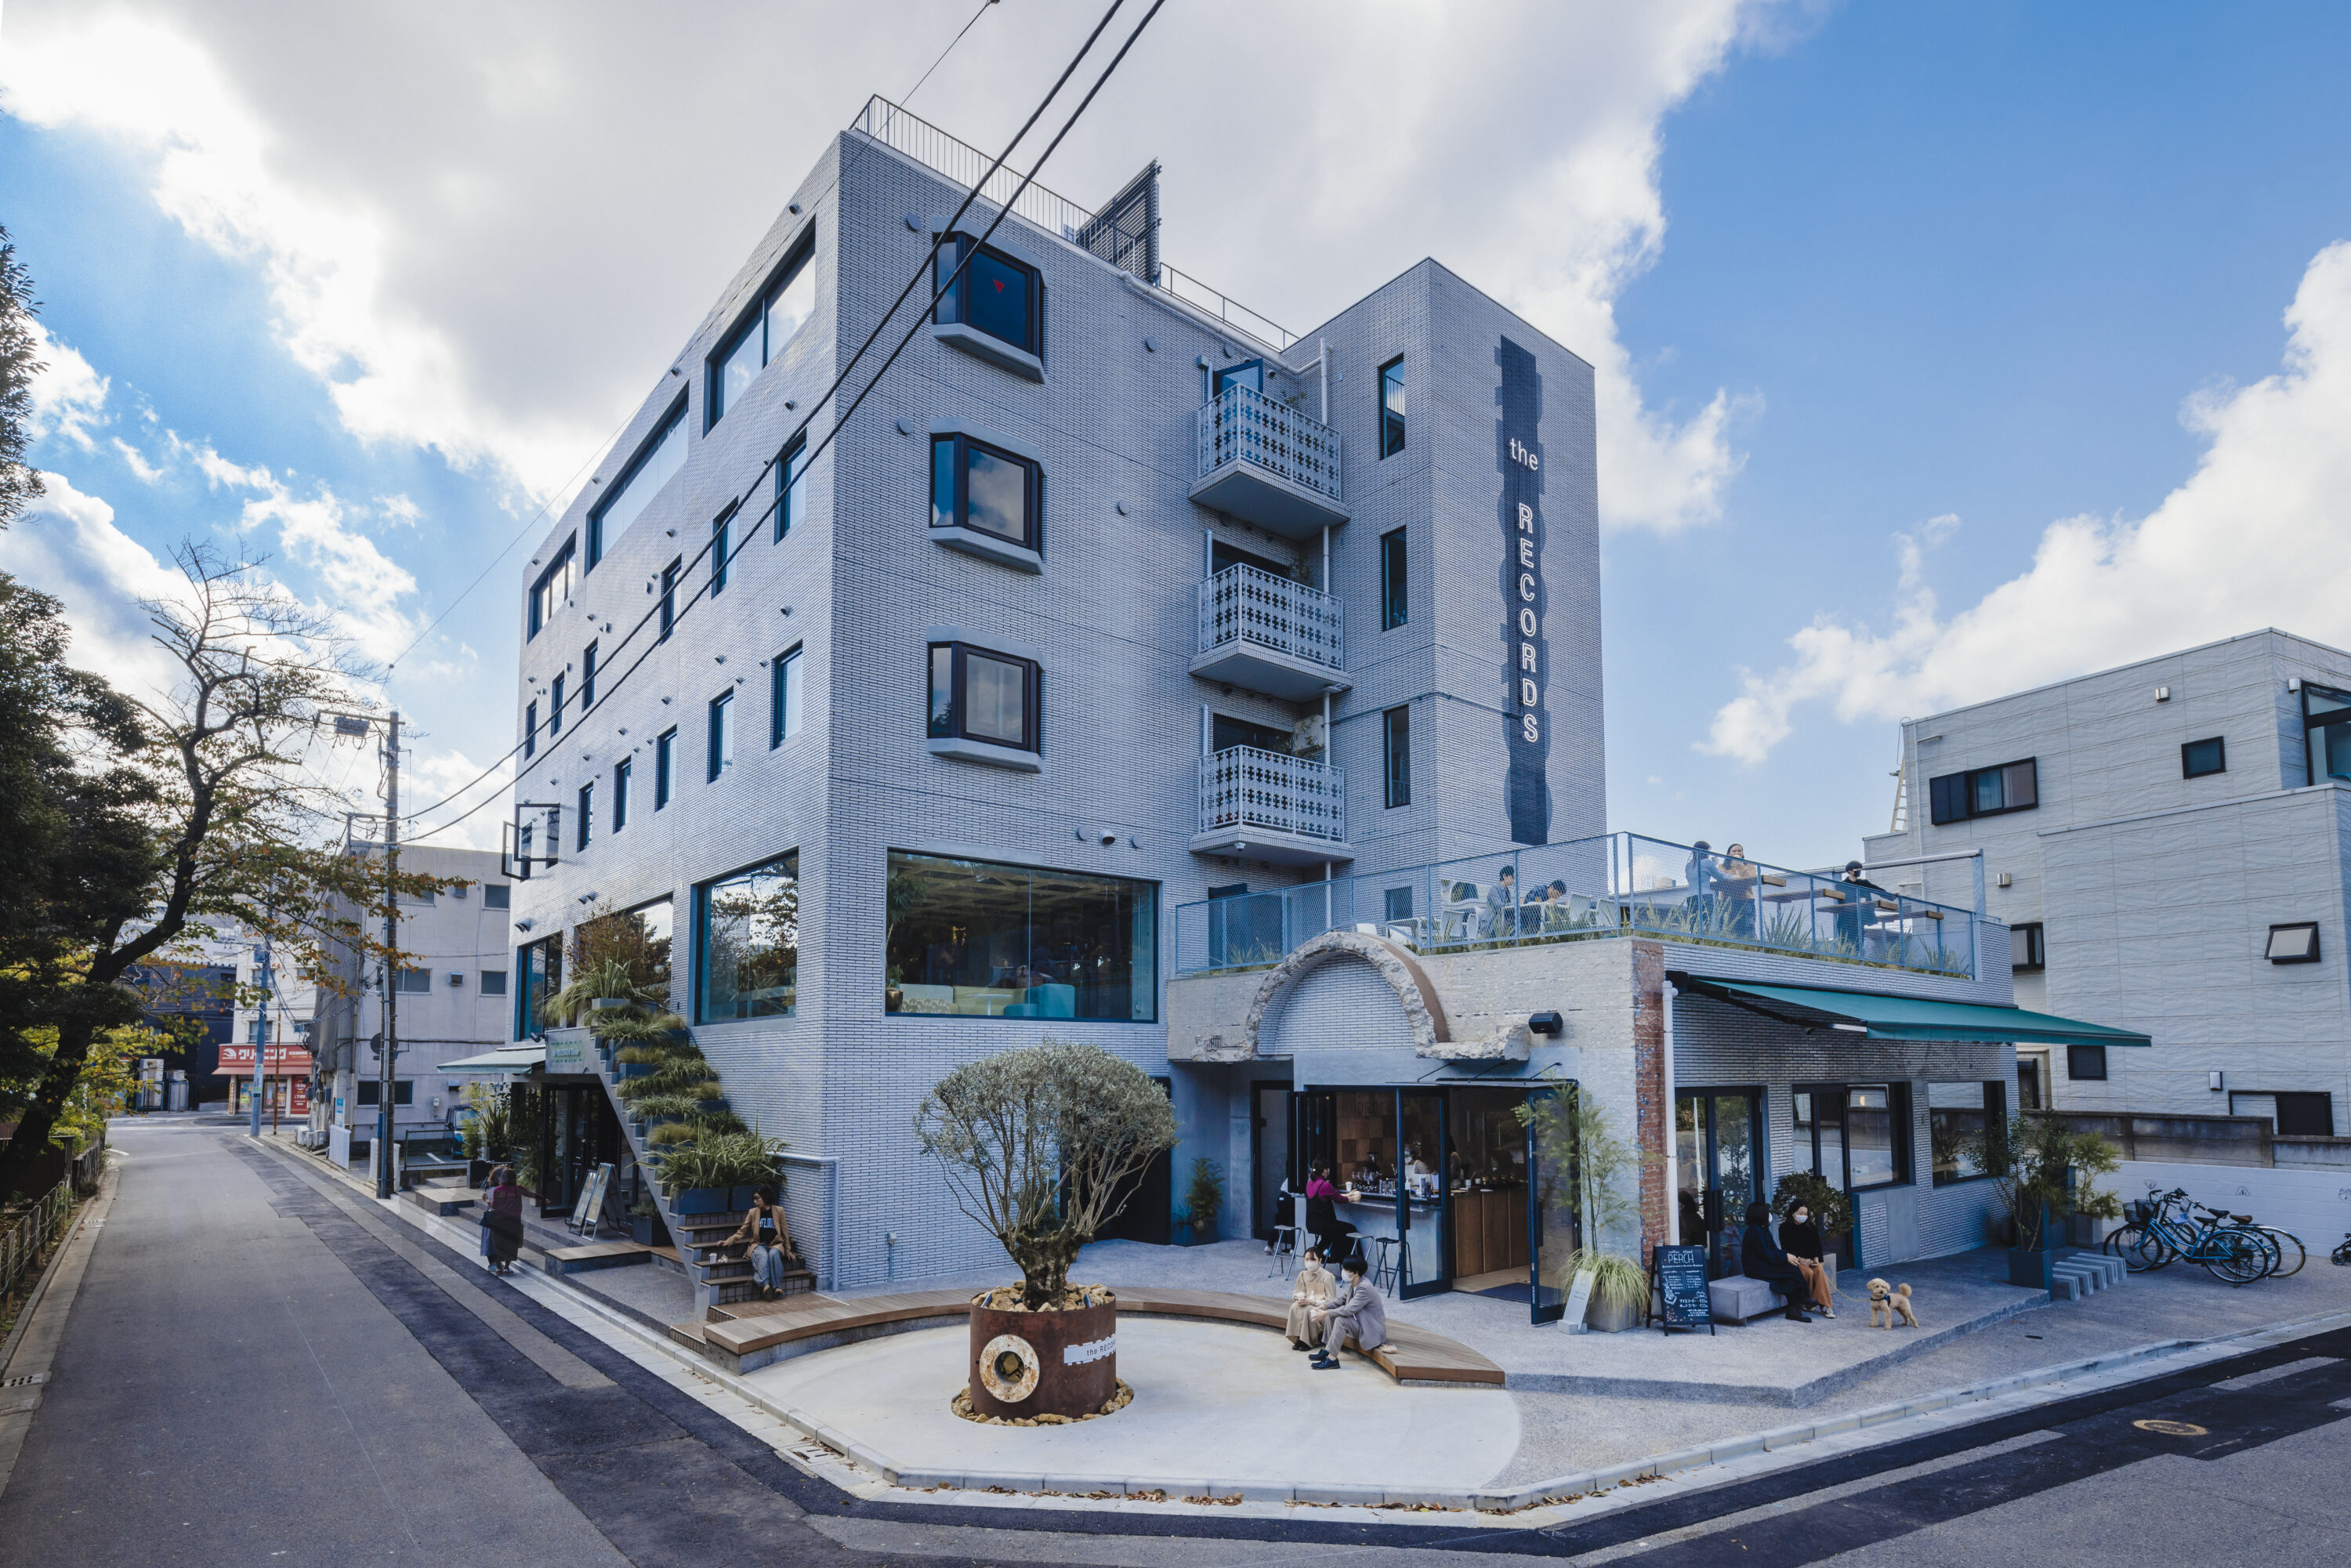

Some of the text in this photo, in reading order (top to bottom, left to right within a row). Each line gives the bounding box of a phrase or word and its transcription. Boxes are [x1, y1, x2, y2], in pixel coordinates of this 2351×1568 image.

[1509, 438, 1538, 743] the RECORDS
[238, 1048, 288, 1060] クリニング
[1357, 1101, 1393, 1119] PERC
[1668, 1253, 1694, 1264] PERCH
